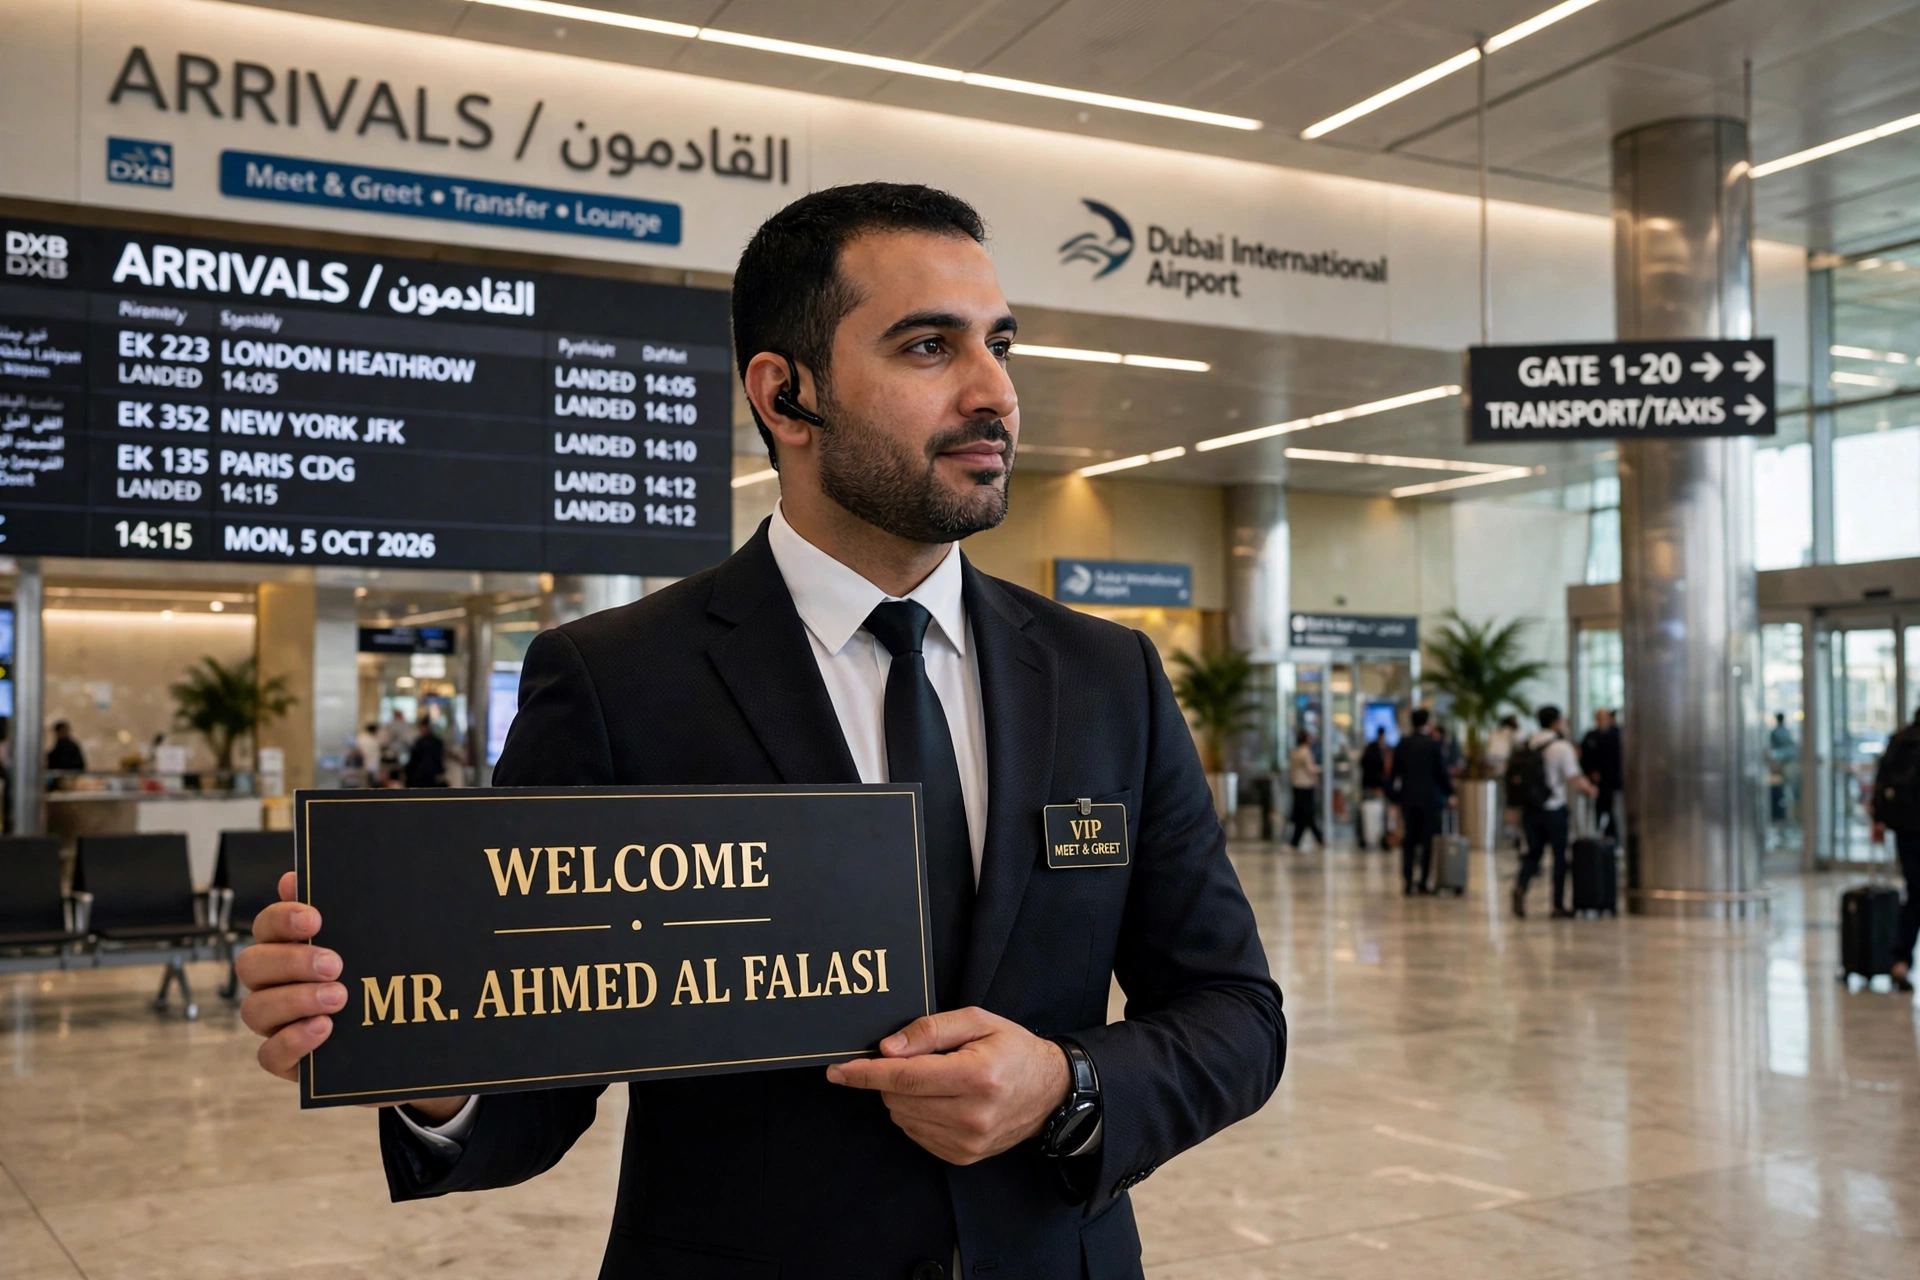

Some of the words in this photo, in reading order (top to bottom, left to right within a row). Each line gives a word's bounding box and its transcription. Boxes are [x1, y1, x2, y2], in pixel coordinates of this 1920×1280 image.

[108, 46, 494, 150] ARRIVALS
[560, 120, 789, 185] القادمون
[110, 159, 171, 185] DXB
[246, 161, 317, 194] Meet
[322, 172, 345, 198] &
[351, 174, 425, 206] Greet
[451, 185, 549, 220] Transfer
[575, 200, 662, 237] Lounge
[6, 231, 68, 259] DXB
[1147, 225, 1225, 262] Dubai
[1231, 236, 1388, 283] International
[6, 257, 68, 280] DXB
[112, 242, 350, 303] ARRIVALS
[1147, 259, 1241, 299] Airport
[388, 276, 535, 317] القادمون
[118, 330, 155, 358] EK
[160, 333, 210, 363] 223
[221, 339, 332, 373] LONDON
[337, 348, 476, 383] HEATHROW
[118, 362, 203, 389] LANDED
[221, 370, 279, 395] 14:05
[555, 365, 637, 394] LANDED
[644, 373, 697, 399] 14:05
[1518, 355, 1601, 388] GATE
[1609, 352, 1683, 386] 1-20
[118, 400, 154, 429] EK
[159, 403, 210, 432] 352
[221, 407, 284, 437] NEW
[287, 412, 359, 442] YORK
[362, 417, 406, 445] JFK
[555, 393, 637, 421] LANDED
[644, 401, 698, 426] 14:10
[1485, 394, 1727, 430] TRANSPORT/TAXIS
[117, 443, 154, 472] EK
[160, 446, 210, 475] 135
[555, 432, 637, 458] LANDED
[644, 438, 698, 463] 14:10
[219, 449, 295, 480] PARIS
[299, 454, 356, 483] CDG
[117, 476, 202, 502] LANDED
[220, 481, 279, 506] 14:15
[555, 469, 637, 496] LANDED
[644, 475, 697, 500] 14:12
[554, 498, 636, 524] LANDED
[644, 503, 697, 527] 14:12
[115, 520, 193, 551] 14:15
[224, 525, 295, 557] MON,
[300, 528, 318, 555] 5
[321, 529, 374, 556] OCT
[376, 531, 437, 559] 2026
[1069, 819, 1102, 840] VIP
[1054, 843, 1080, 857] MEET
[1082, 842, 1090, 855] &
[1091, 842, 1121, 855] GREET
[484, 841, 769, 897] WELCOME
[361, 973, 459, 1026] MR.
[473, 961, 658, 1019] AHMED
[671, 958, 731, 1006] AL
[742, 948, 890, 1001] FALASI
